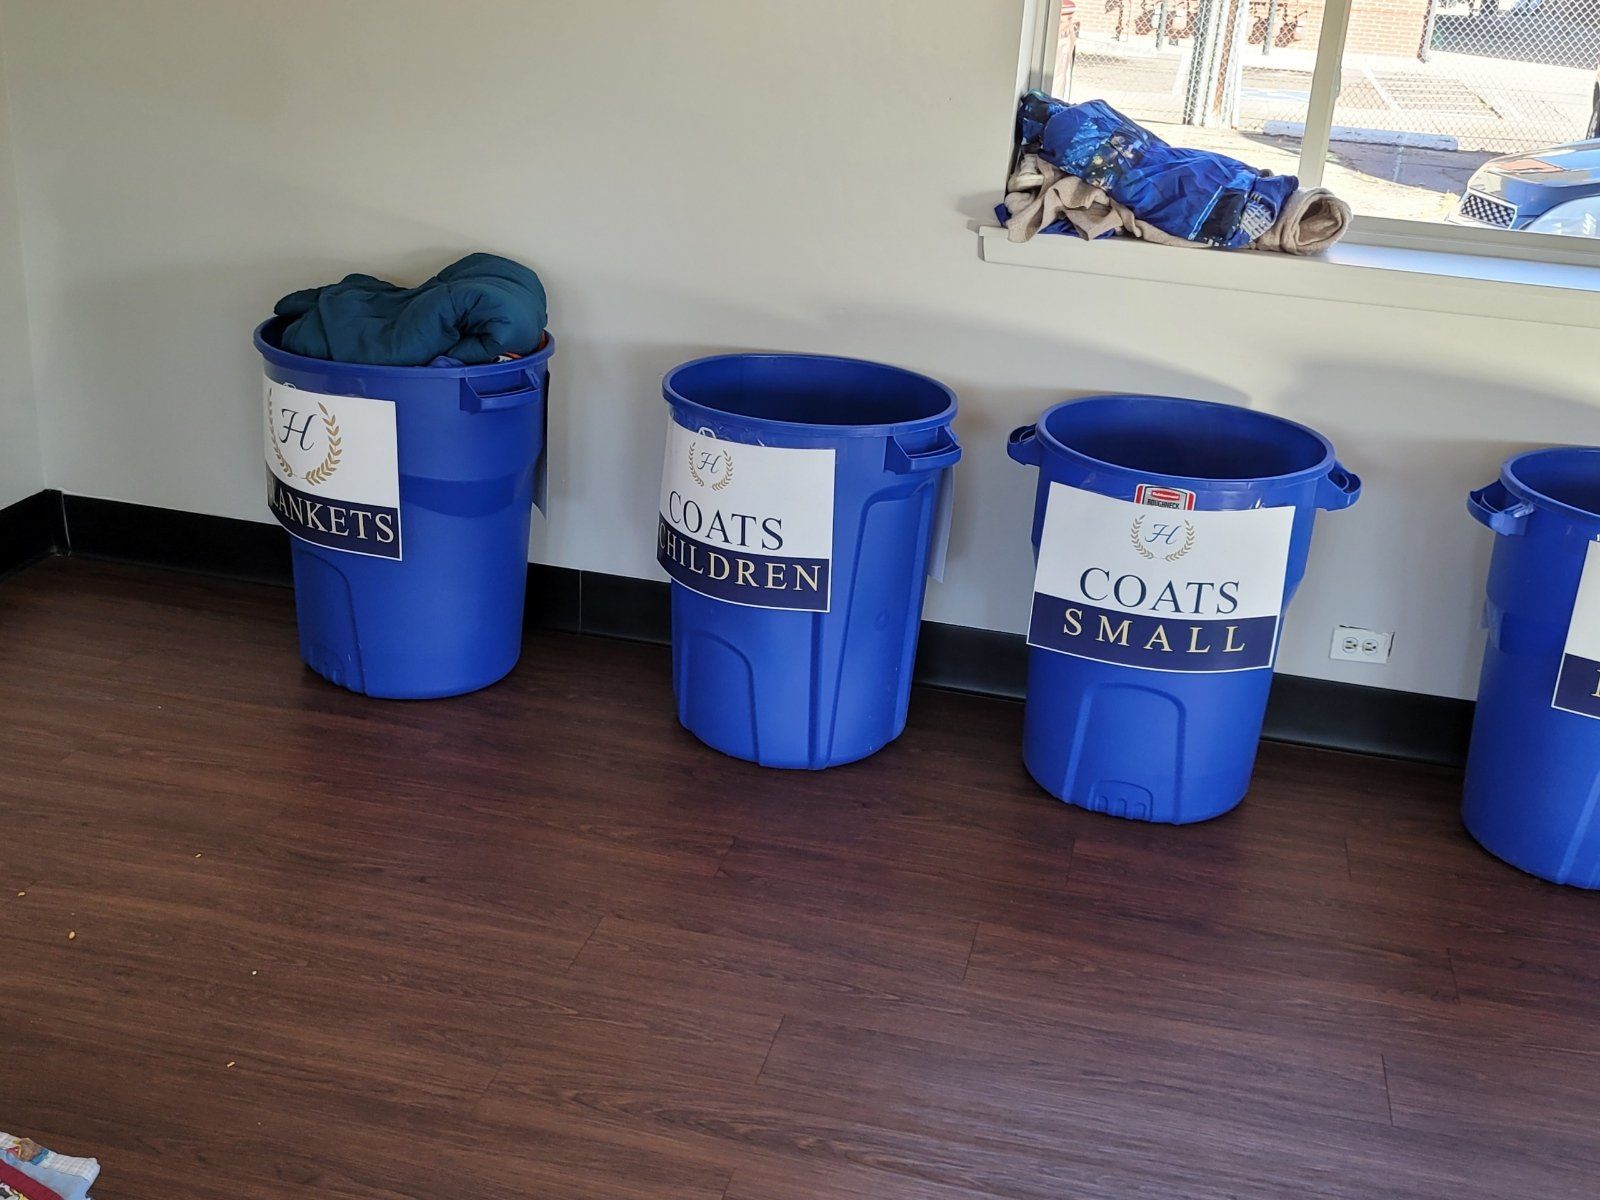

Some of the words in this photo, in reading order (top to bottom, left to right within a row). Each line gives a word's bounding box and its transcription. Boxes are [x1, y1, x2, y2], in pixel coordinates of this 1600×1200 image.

[669, 490, 784, 551] COATS
[658, 522, 821, 592] CHILDREN
[1079, 567, 1240, 615] COATS
[1063, 607, 1246, 653] SMALL
